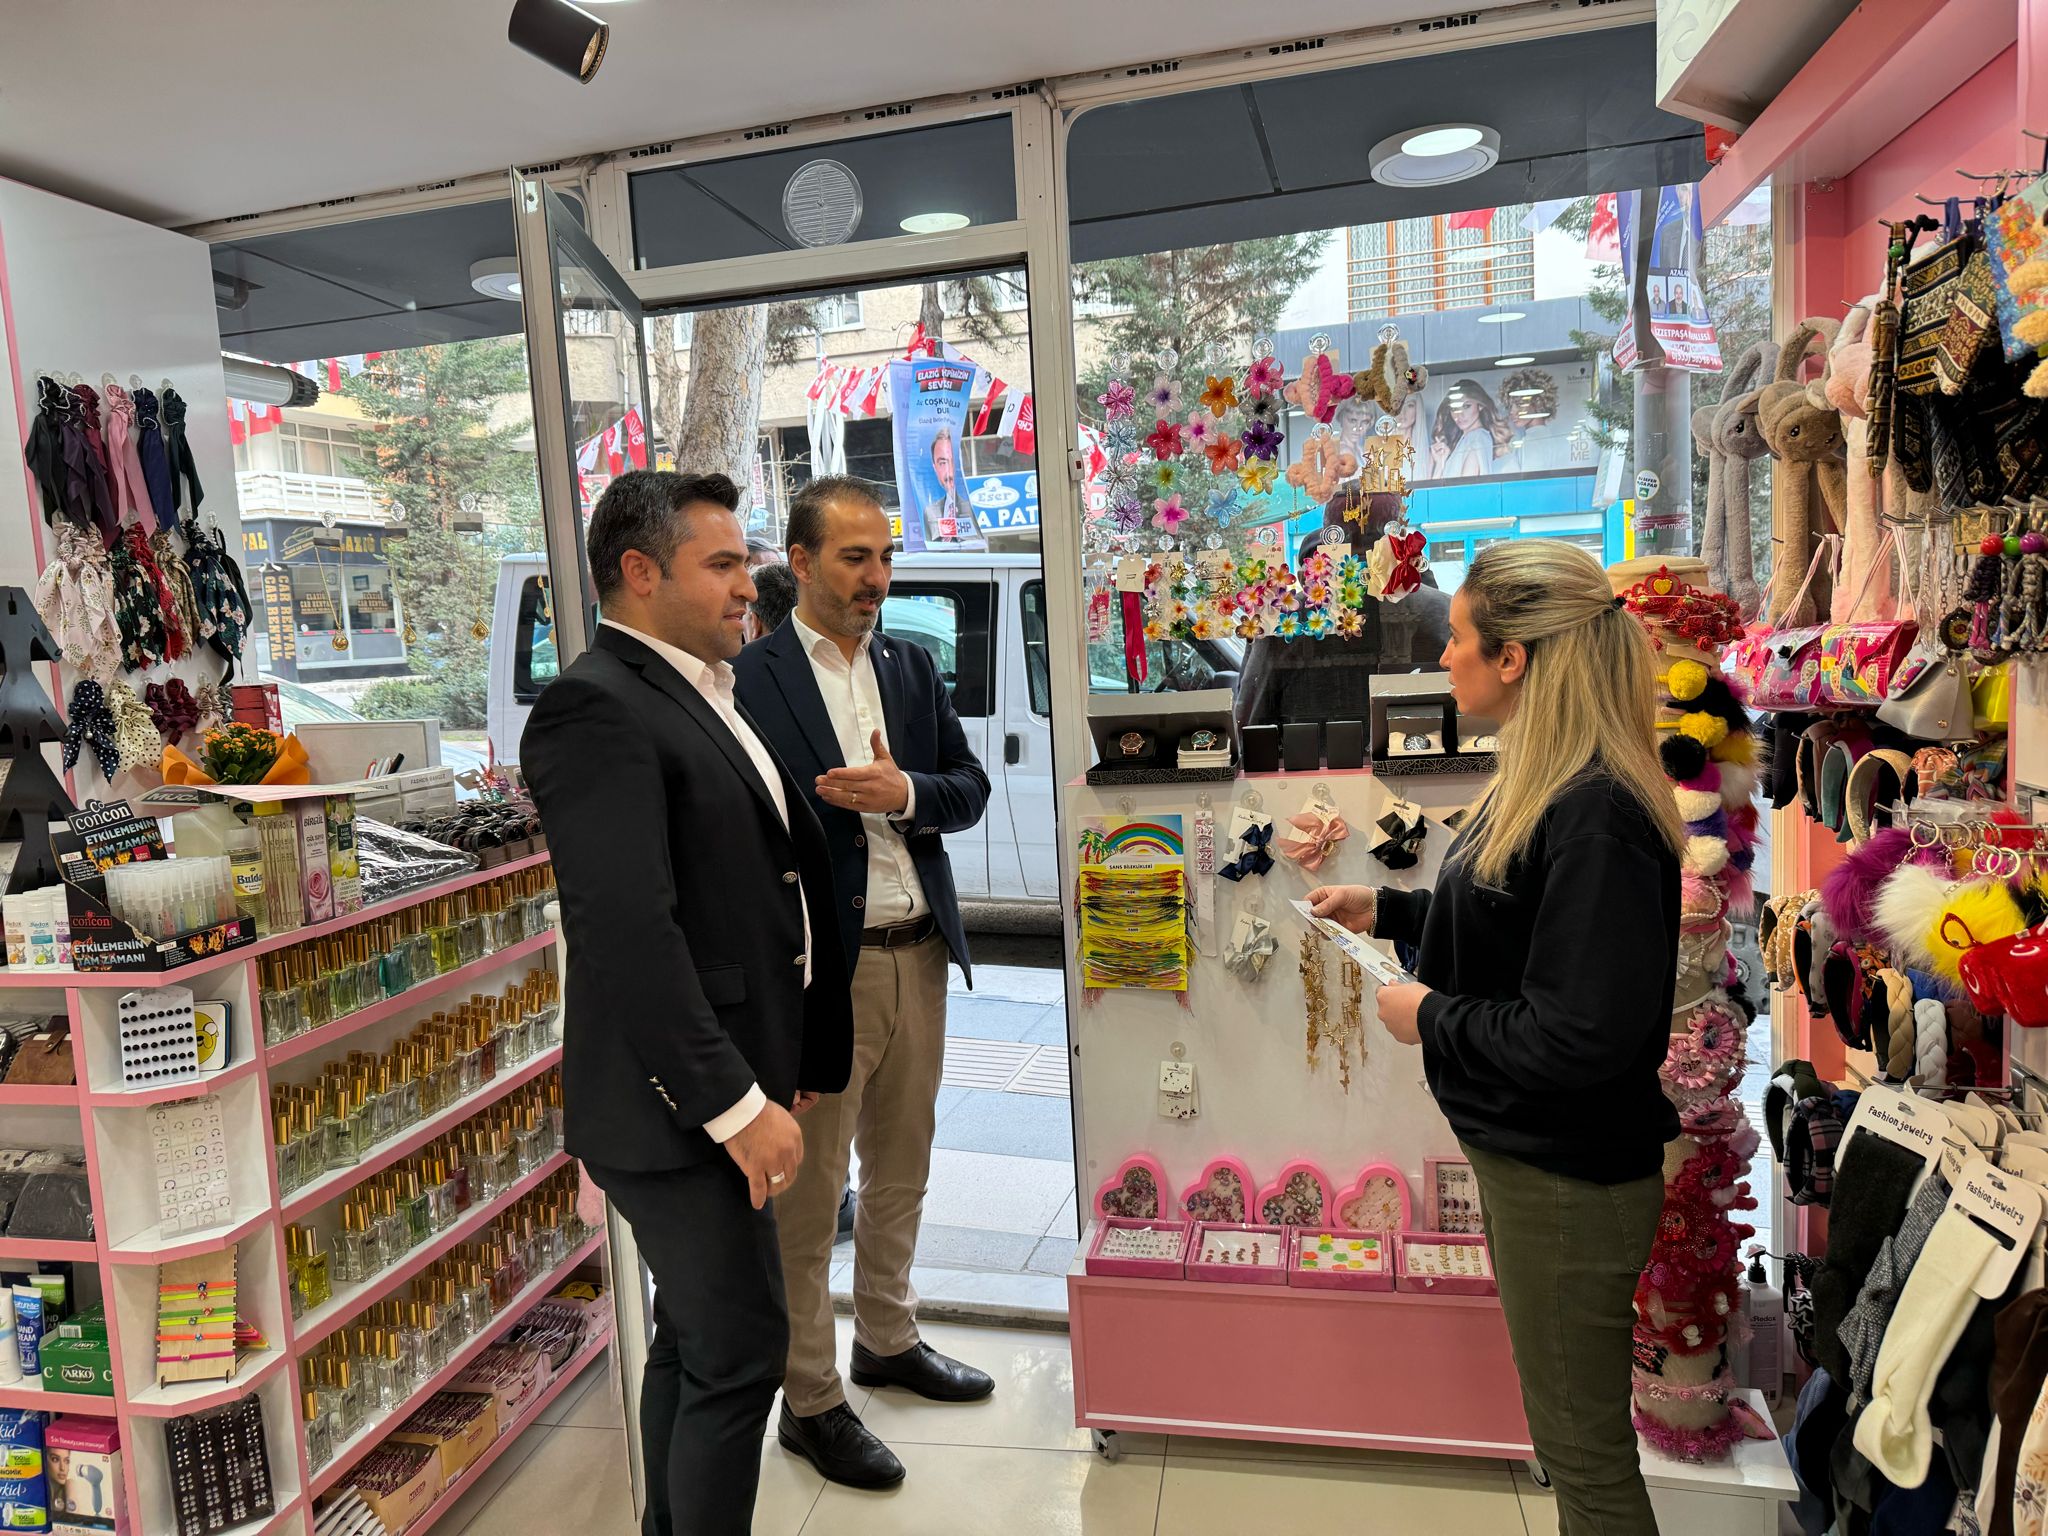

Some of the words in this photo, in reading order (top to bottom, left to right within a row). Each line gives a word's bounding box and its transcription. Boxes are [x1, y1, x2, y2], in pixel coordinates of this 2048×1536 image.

[85, 818, 156, 845] ETKİLEMENİN
[116, 832, 161, 852] ZAMANI
[74, 939, 145, 954] ETKİLEMENİN
[103, 952, 146, 965] ZAMANI
[1867, 1105, 1899, 1129] Fashion
[1897, 1119, 1934, 1145] jewelry
[1965, 1181, 1992, 1204] Fashion
[1990, 1196, 2025, 1226] jewelry
[65, 1369, 92, 1379] ARKO
[0, 1424, 17, 1438] kid
